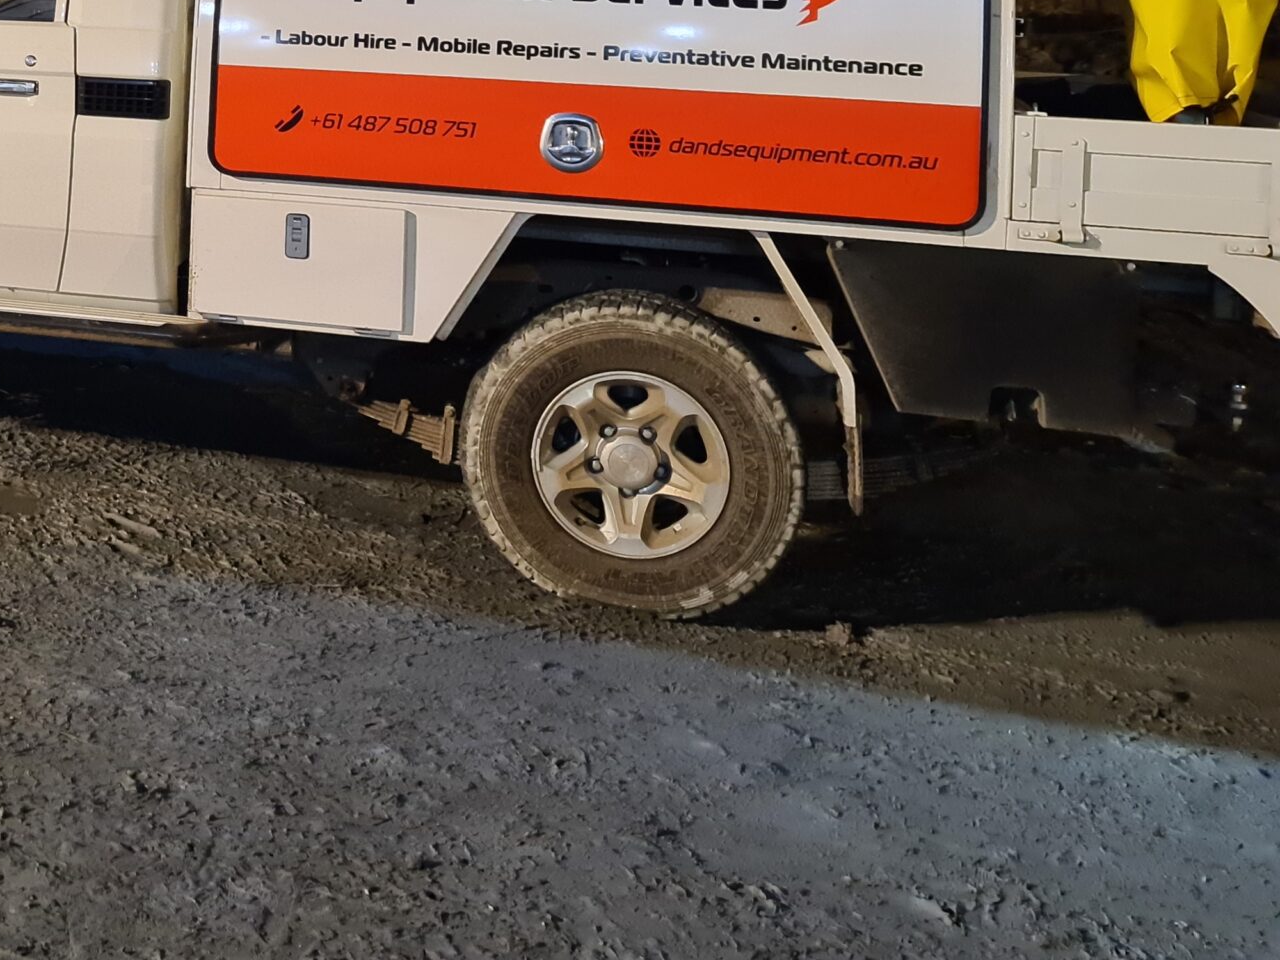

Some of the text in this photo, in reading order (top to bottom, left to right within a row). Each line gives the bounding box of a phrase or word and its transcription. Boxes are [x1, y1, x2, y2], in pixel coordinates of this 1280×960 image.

[276, 29, 349, 48] Labour
[353, 33, 396, 50] Hire
[417, 36, 491, 55] Mobile
[496, 40, 581, 60] Repairs
[603, 45, 755, 68] Preventative
[761, 53, 924, 77] Maintenance
[311, 113, 477, 138] +61 487 508 751
[668, 136, 939, 171] dandsequipment.com.au
